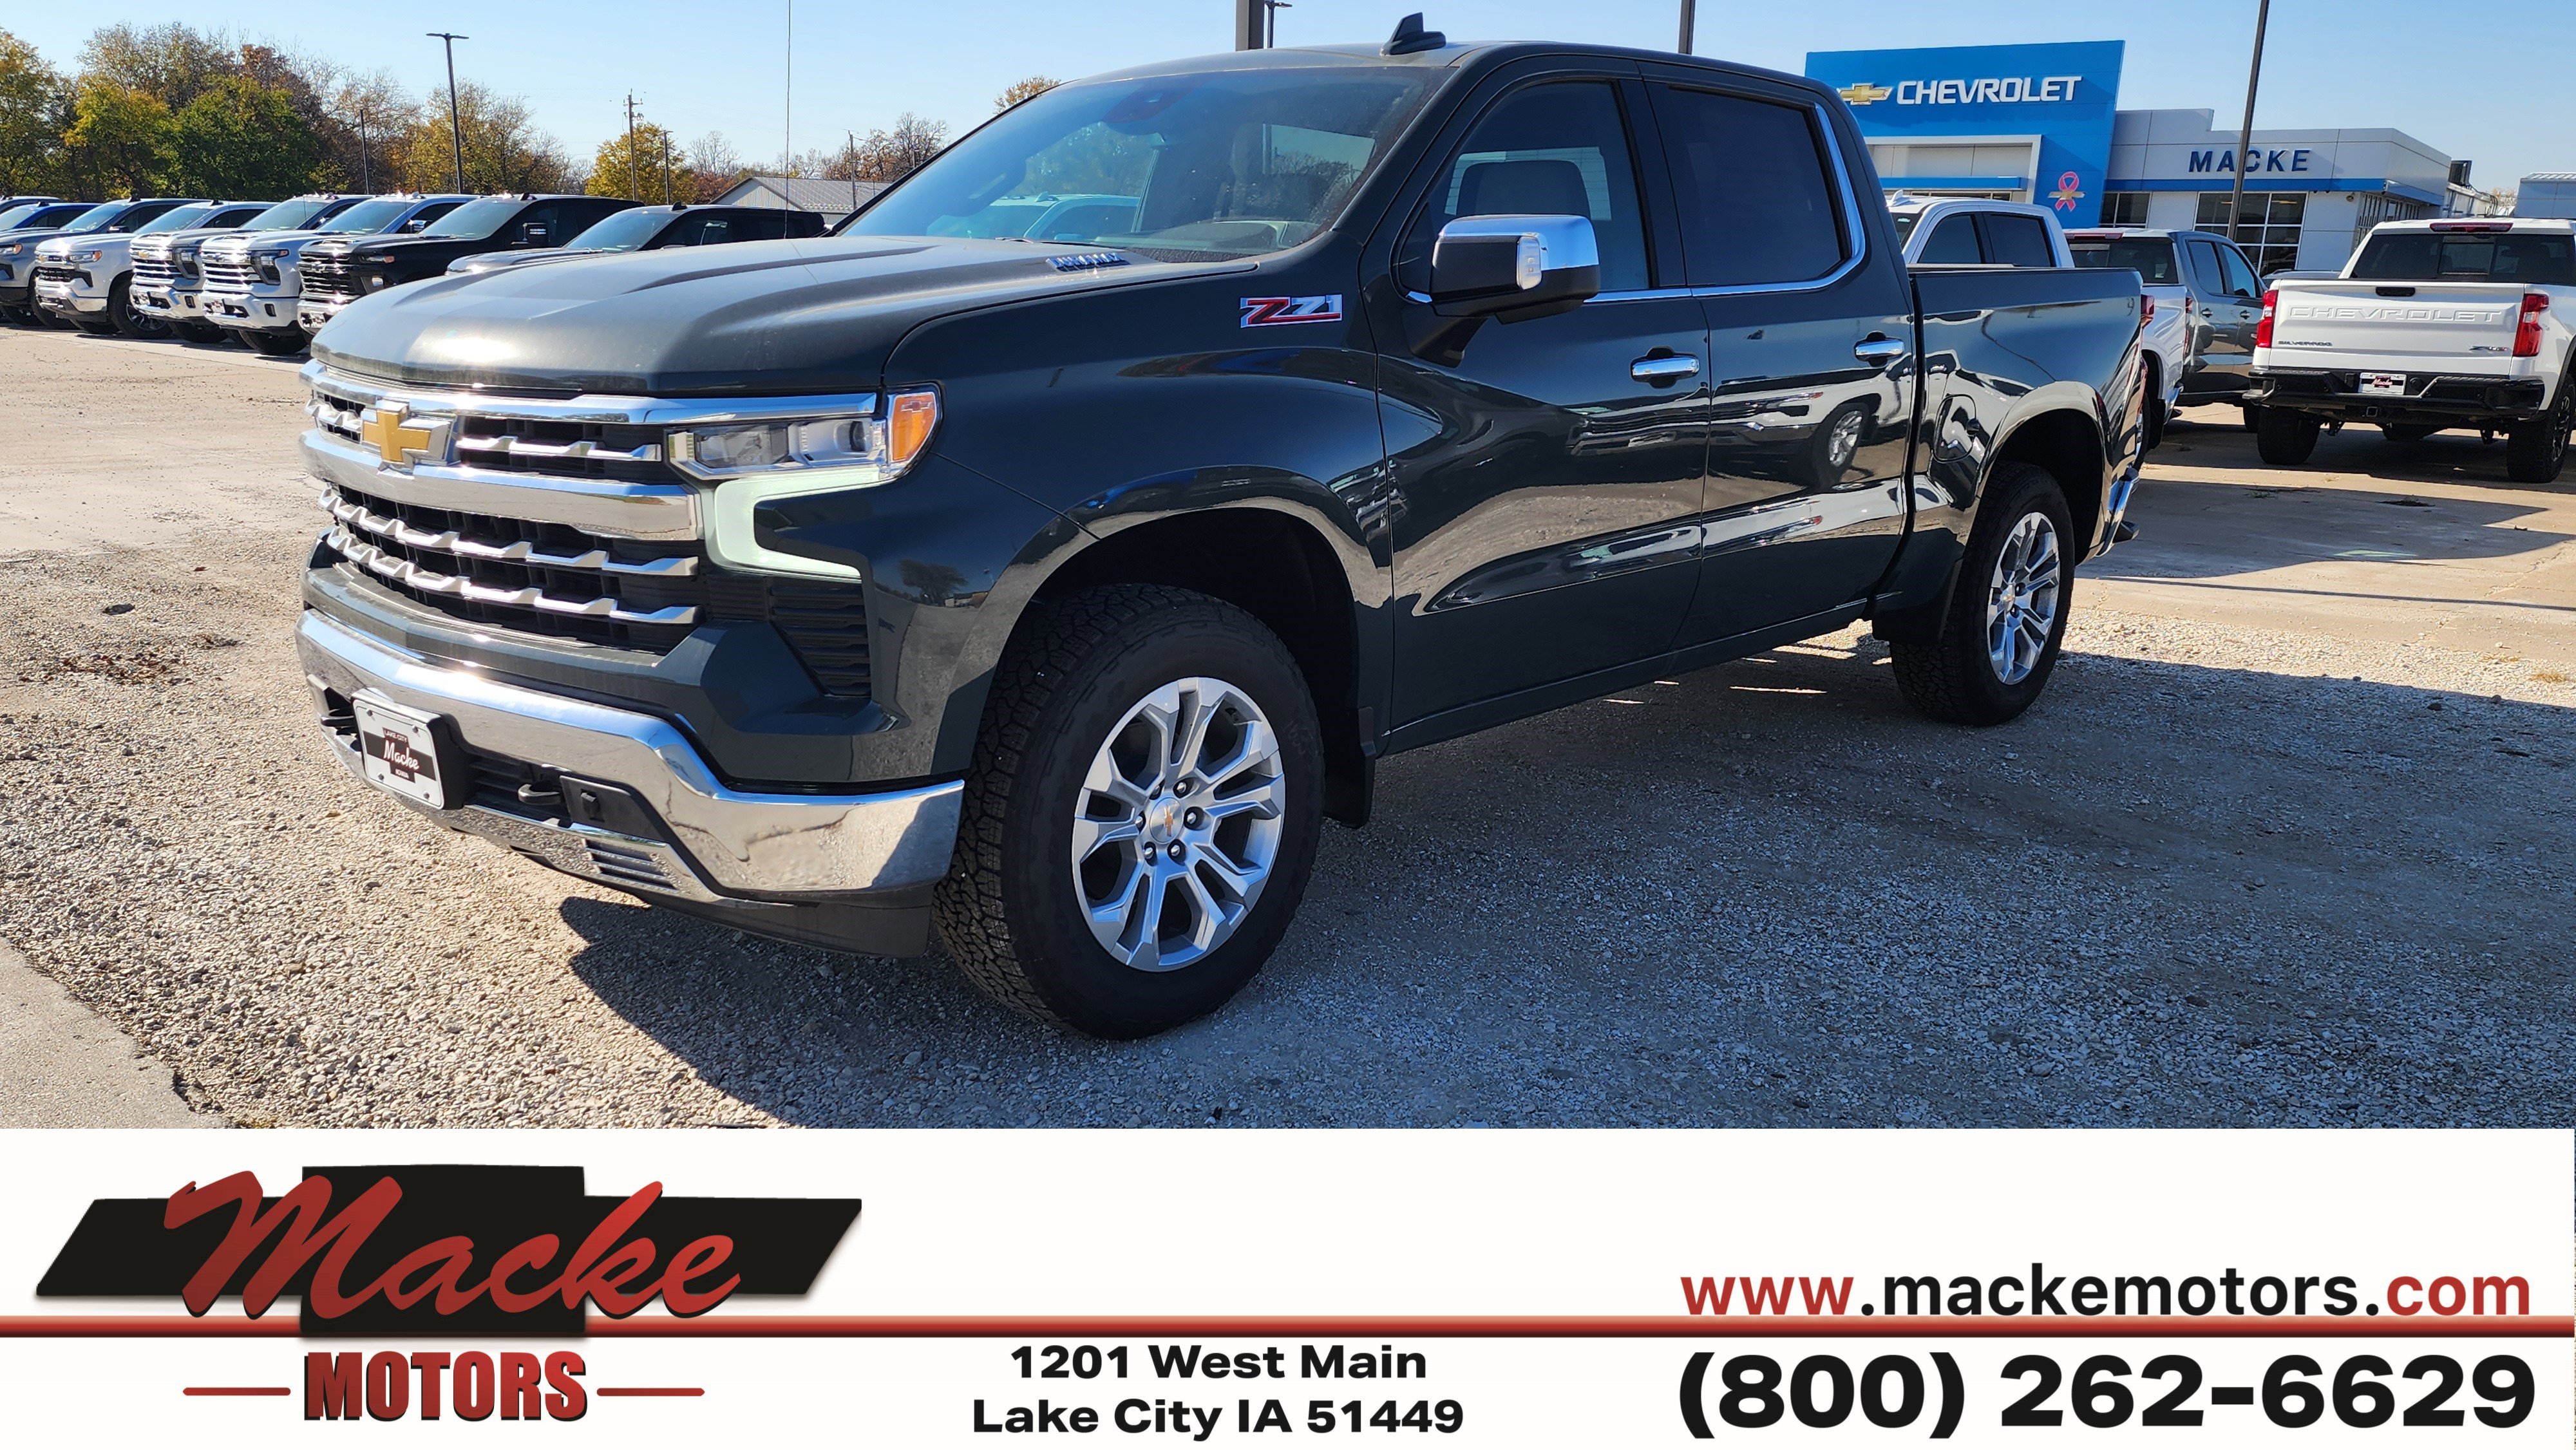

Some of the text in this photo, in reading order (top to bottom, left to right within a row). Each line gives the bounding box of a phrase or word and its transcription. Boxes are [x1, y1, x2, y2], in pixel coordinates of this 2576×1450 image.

[1897, 75, 2082, 105] CHEVROLET
[2188, 149, 2311, 173] MACKE
[1239, 294, 1343, 328] Z71
[2289, 306, 2502, 323] CHEVROLET
[383, 739, 420, 770] Macke
